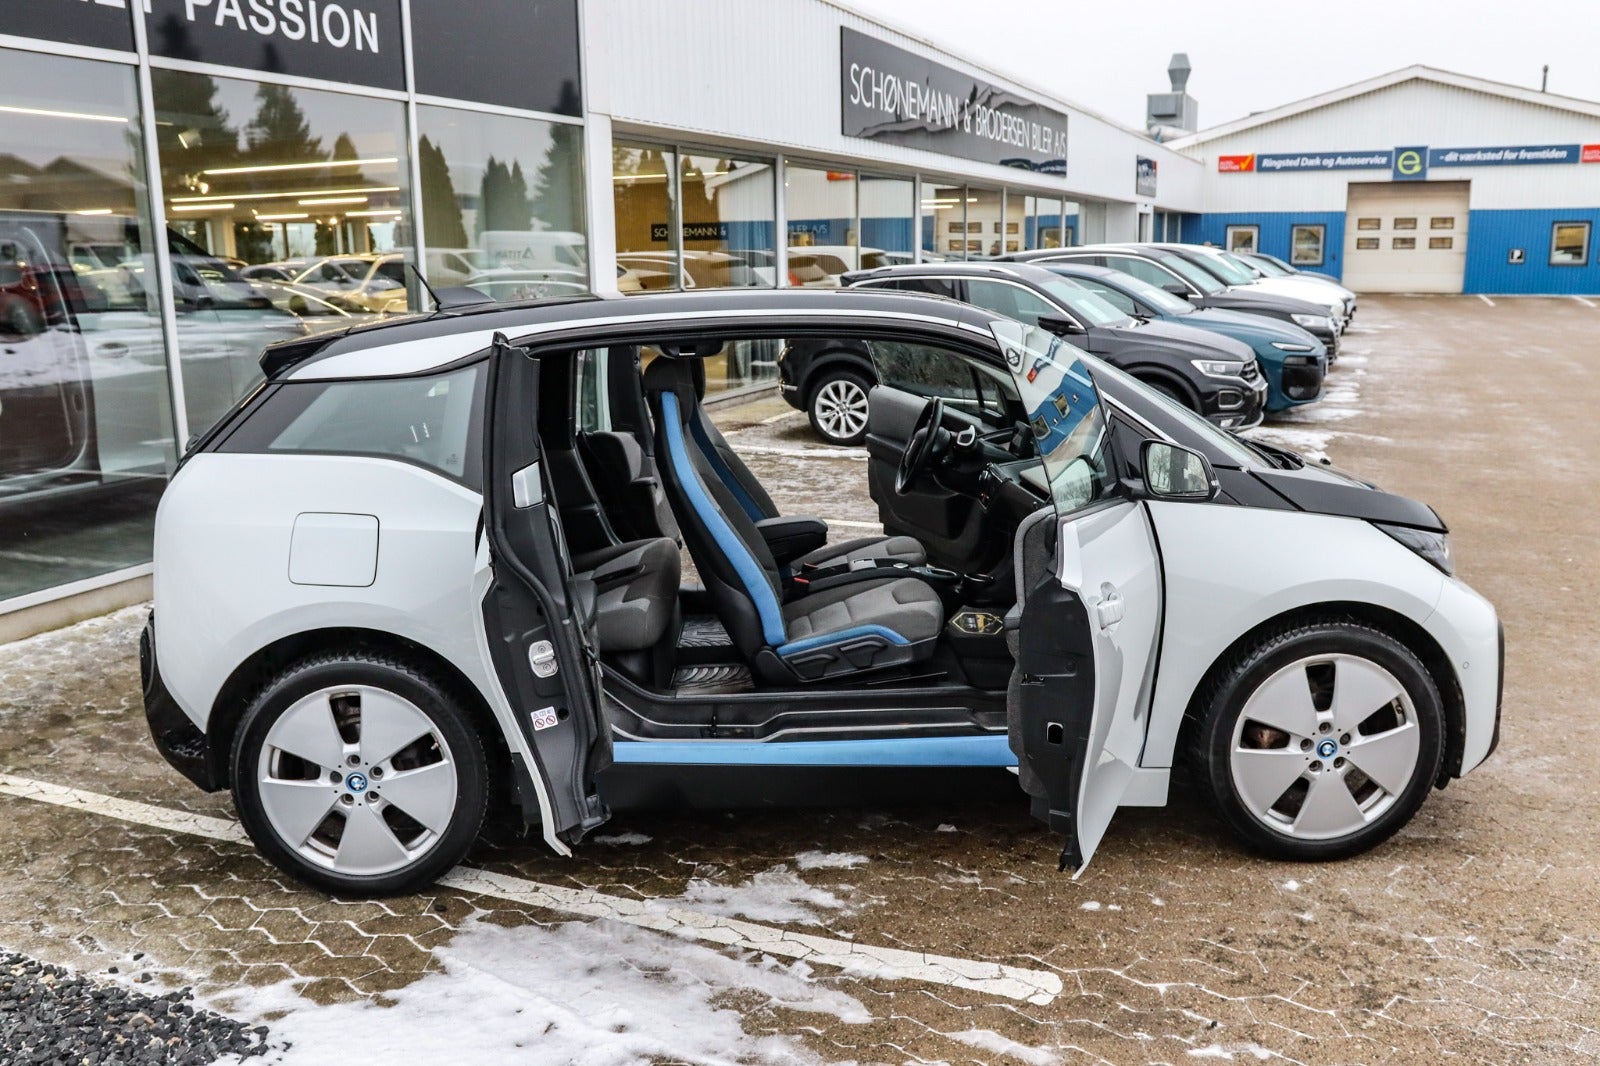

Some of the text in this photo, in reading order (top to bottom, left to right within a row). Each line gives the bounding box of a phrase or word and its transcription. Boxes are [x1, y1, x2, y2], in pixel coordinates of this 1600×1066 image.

[850, 63, 959, 131] SCHØNEMANN
[963, 98, 972, 134] &
[976, 104, 1030, 149] BRODERSEN
[1032, 122, 1052, 154] BILER
[1262, 157, 1299, 170] Ringsted
[1322, 157, 1335, 168] og
[1336, 155, 1388, 167] Autoservice
